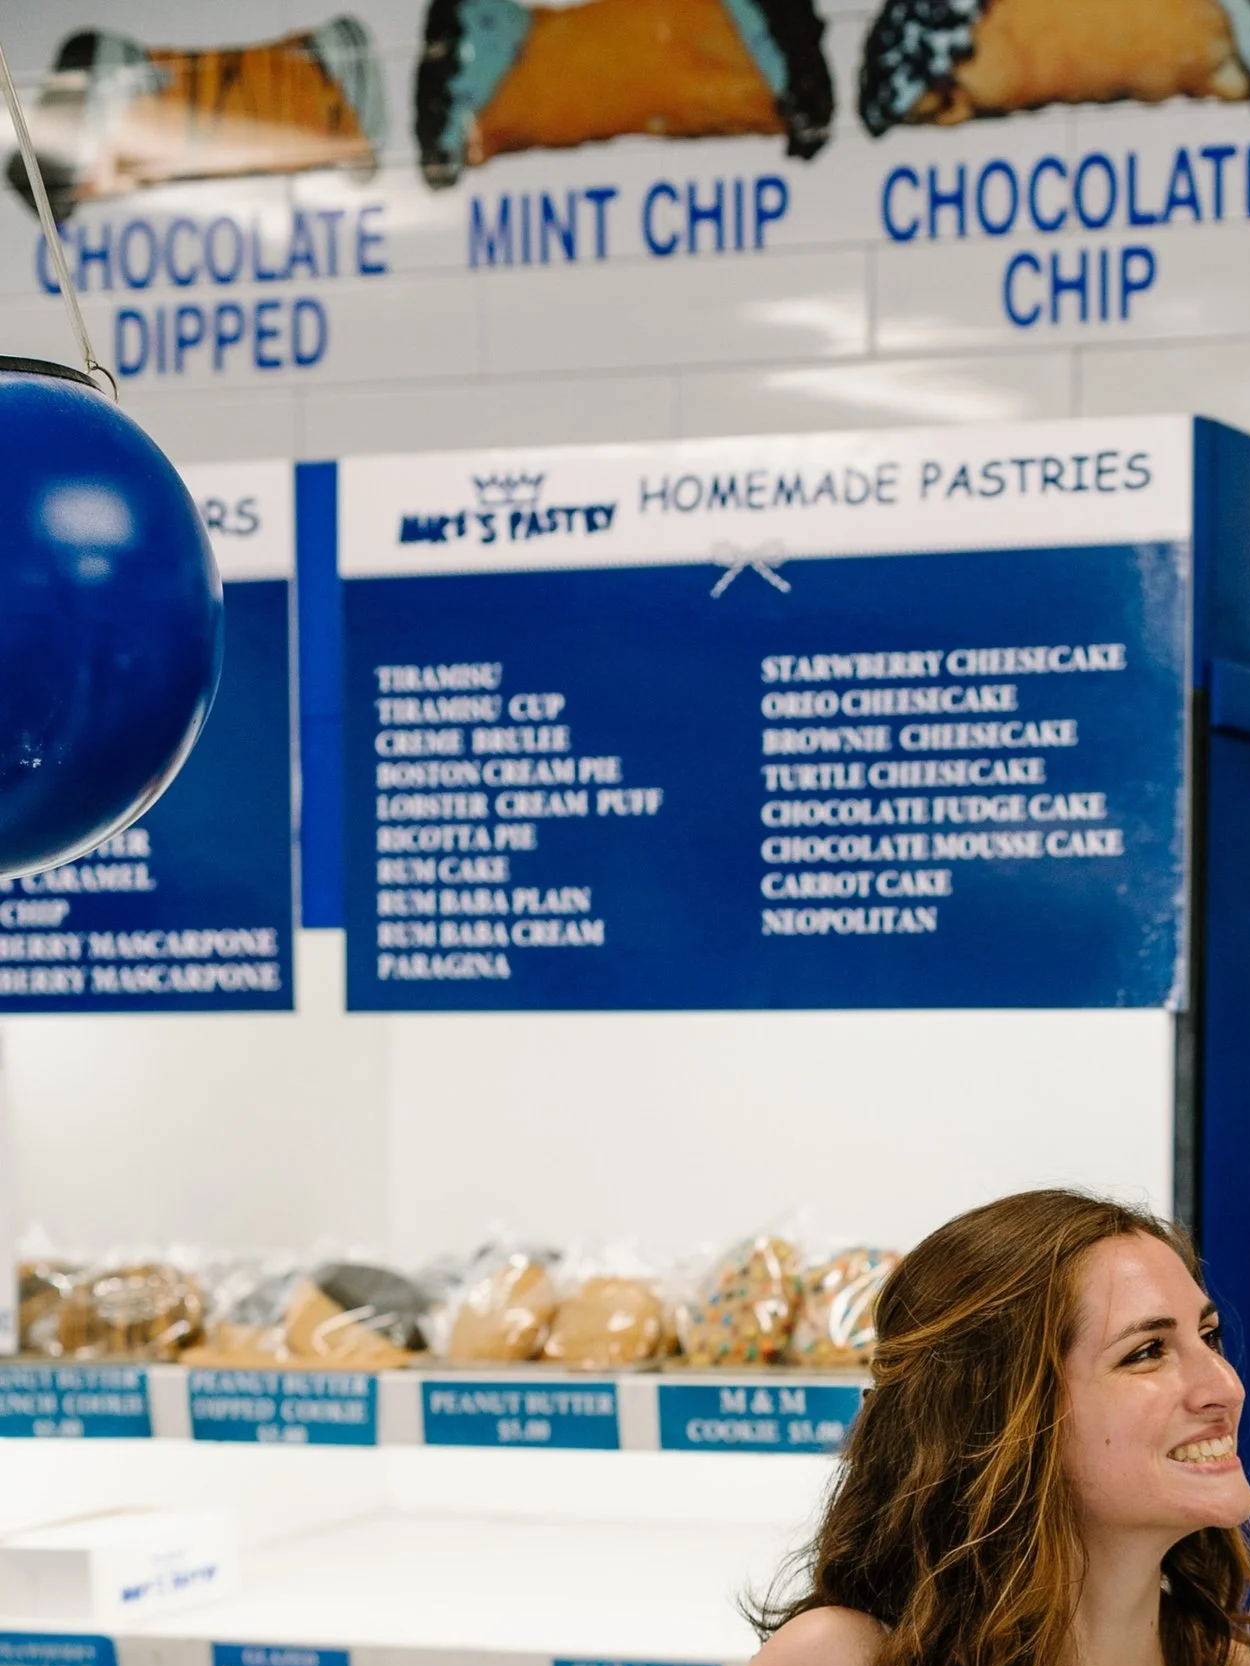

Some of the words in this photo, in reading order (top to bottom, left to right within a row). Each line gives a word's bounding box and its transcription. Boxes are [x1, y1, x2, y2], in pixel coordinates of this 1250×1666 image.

[468, 187, 618, 269] MINT
[641, 175, 789, 258] CHIP
[34, 205, 389, 296] CHOCOLATE
[1001, 246, 1158, 328] CHIP
[113, 297, 329, 378] DIPPED
[638, 463, 899, 514] HOMEMADE
[920, 452, 1152, 499] PASTRIES
[399, 509, 497, 544] MIKE'S
[509, 501, 617, 540] PASTRY
[946, 643, 1127, 677] CHEESECAKE
[509, 693, 565, 721] CUP
[760, 690, 841, 720] OREO
[841, 684, 1019, 718] CHEESECAKE
[375, 729, 464, 757] CREME
[472, 725, 570, 755] BRULEE
[762, 725, 893, 755] BROWNIE
[899, 719, 1079, 751] CHEESECAKE
[376, 760, 481, 789] BOSTON
[483, 758, 576, 787] CREAM
[578, 756, 622, 785] PIE
[761, 761, 867, 792] TURTLE
[868, 757, 1046, 788] CHEESECAKE
[376, 793, 488, 821] LOBSTER
[495, 790, 589, 819] CREAM
[596, 787, 663, 817] PUFF
[761, 797, 932, 828] CHOCOLATE
[932, 794, 1027, 824] FUDGE
[1028, 792, 1107, 821] CAKE
[376, 825, 491, 853] RICOTTA
[494, 823, 537, 850] PIE
[761, 834, 930, 864] CHOCOLATE
[931, 830, 1046, 861] MOUSSE
[1046, 828, 1125, 857] CAKE
[376, 857, 436, 886] RUM
[438, 855, 510, 884] CAKE
[760, 871, 876, 900] CARROT
[876, 868, 953, 898] CAKE
[0, 898, 70, 928] CHIP
[376, 890, 437, 917] RUM
[439, 888, 510, 916] BABA
[511, 886, 592, 915] PLAIN
[376, 922, 437, 948] RUM
[439, 920, 510, 948] BABA
[511, 918, 604, 947] CREAM
[761, 906, 938, 936] NEOPOLITAN
[87, 927, 278, 959] MASCARPONE
[90, 961, 280, 993] MASCARPONE
[431, 1391, 521, 1415] PEANUT
[525, 1392, 613, 1416] BUTTER
[720, 1388, 747, 1413] M
[778, 1388, 807, 1414] M
[686, 1420, 778, 1443] COOKIE
